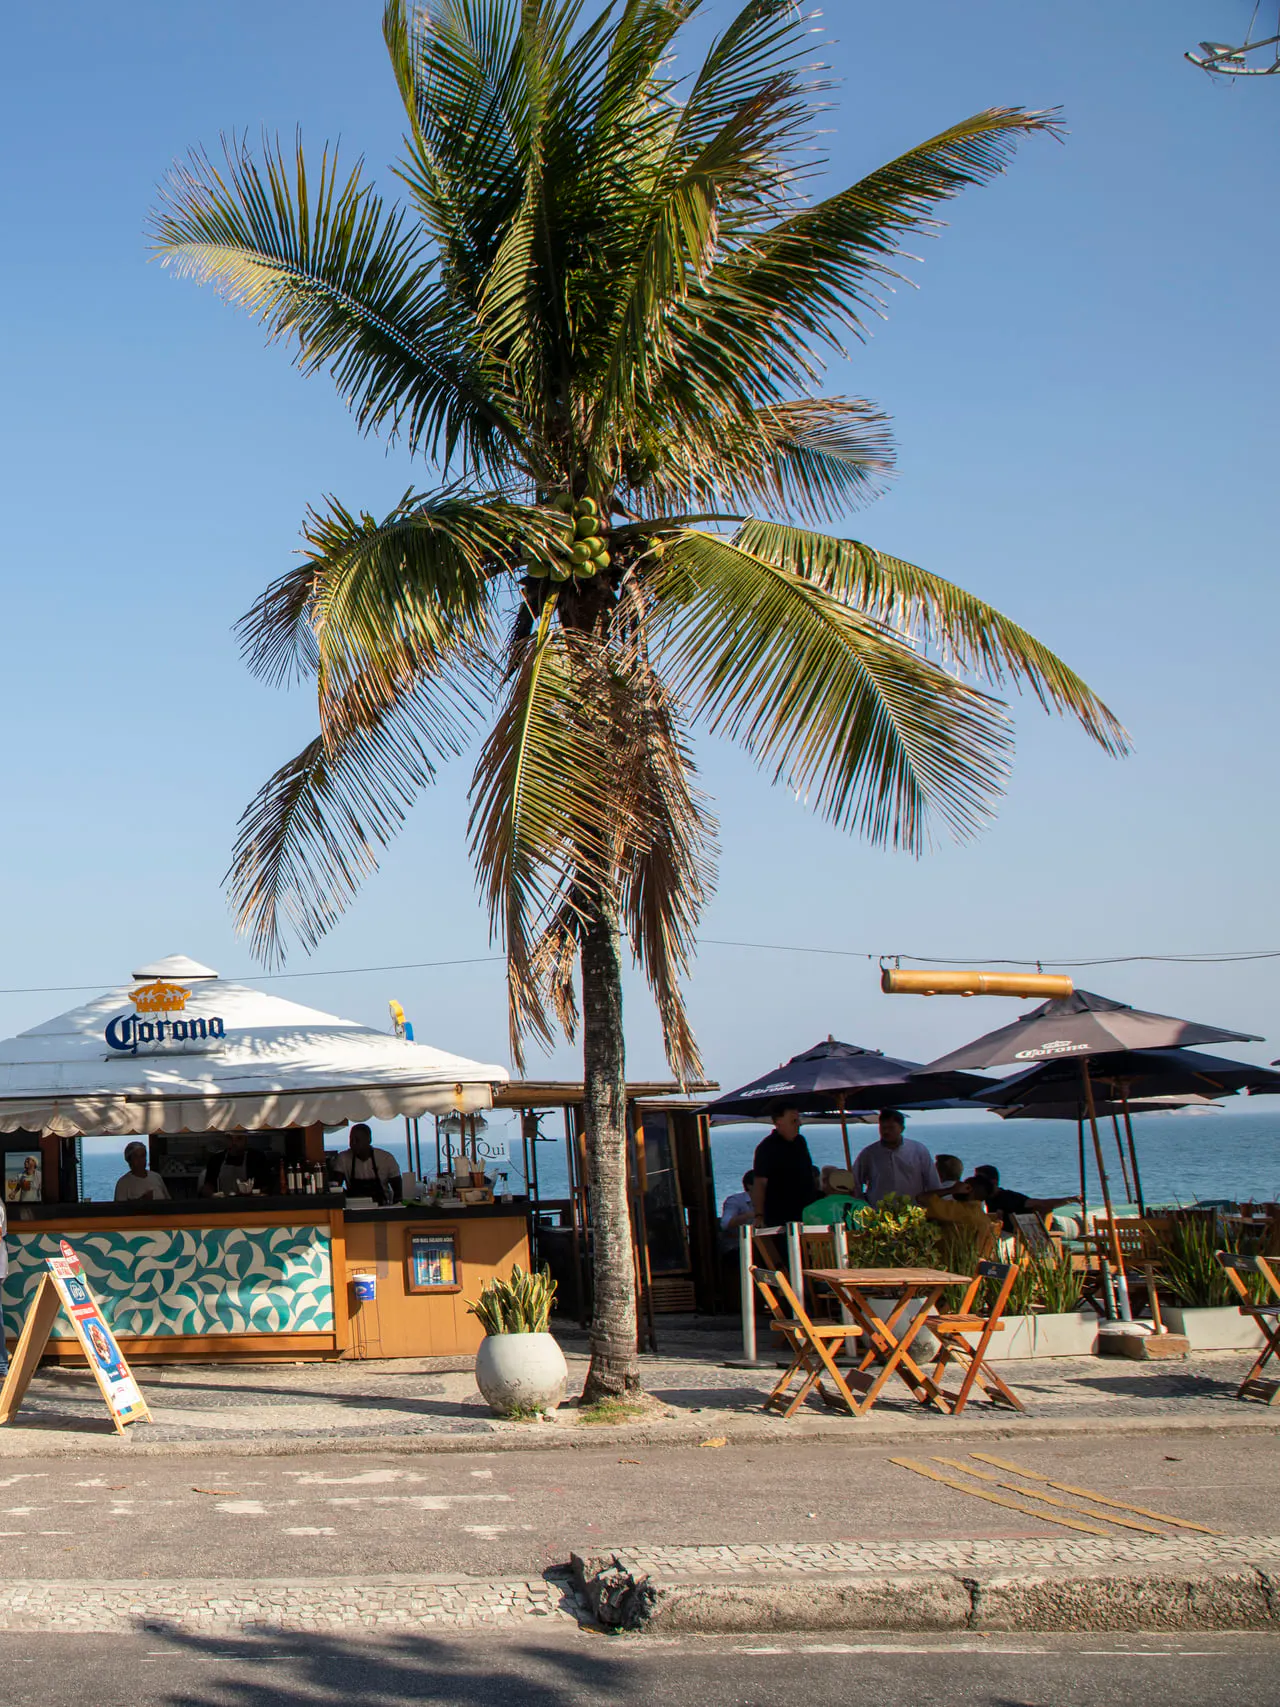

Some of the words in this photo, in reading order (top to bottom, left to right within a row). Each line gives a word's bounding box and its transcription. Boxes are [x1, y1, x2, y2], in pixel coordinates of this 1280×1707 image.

[105, 1013, 227, 1055] Corona
[1015, 1044, 1091, 1058] Corona
[476, 1141, 505, 1159] Qui
